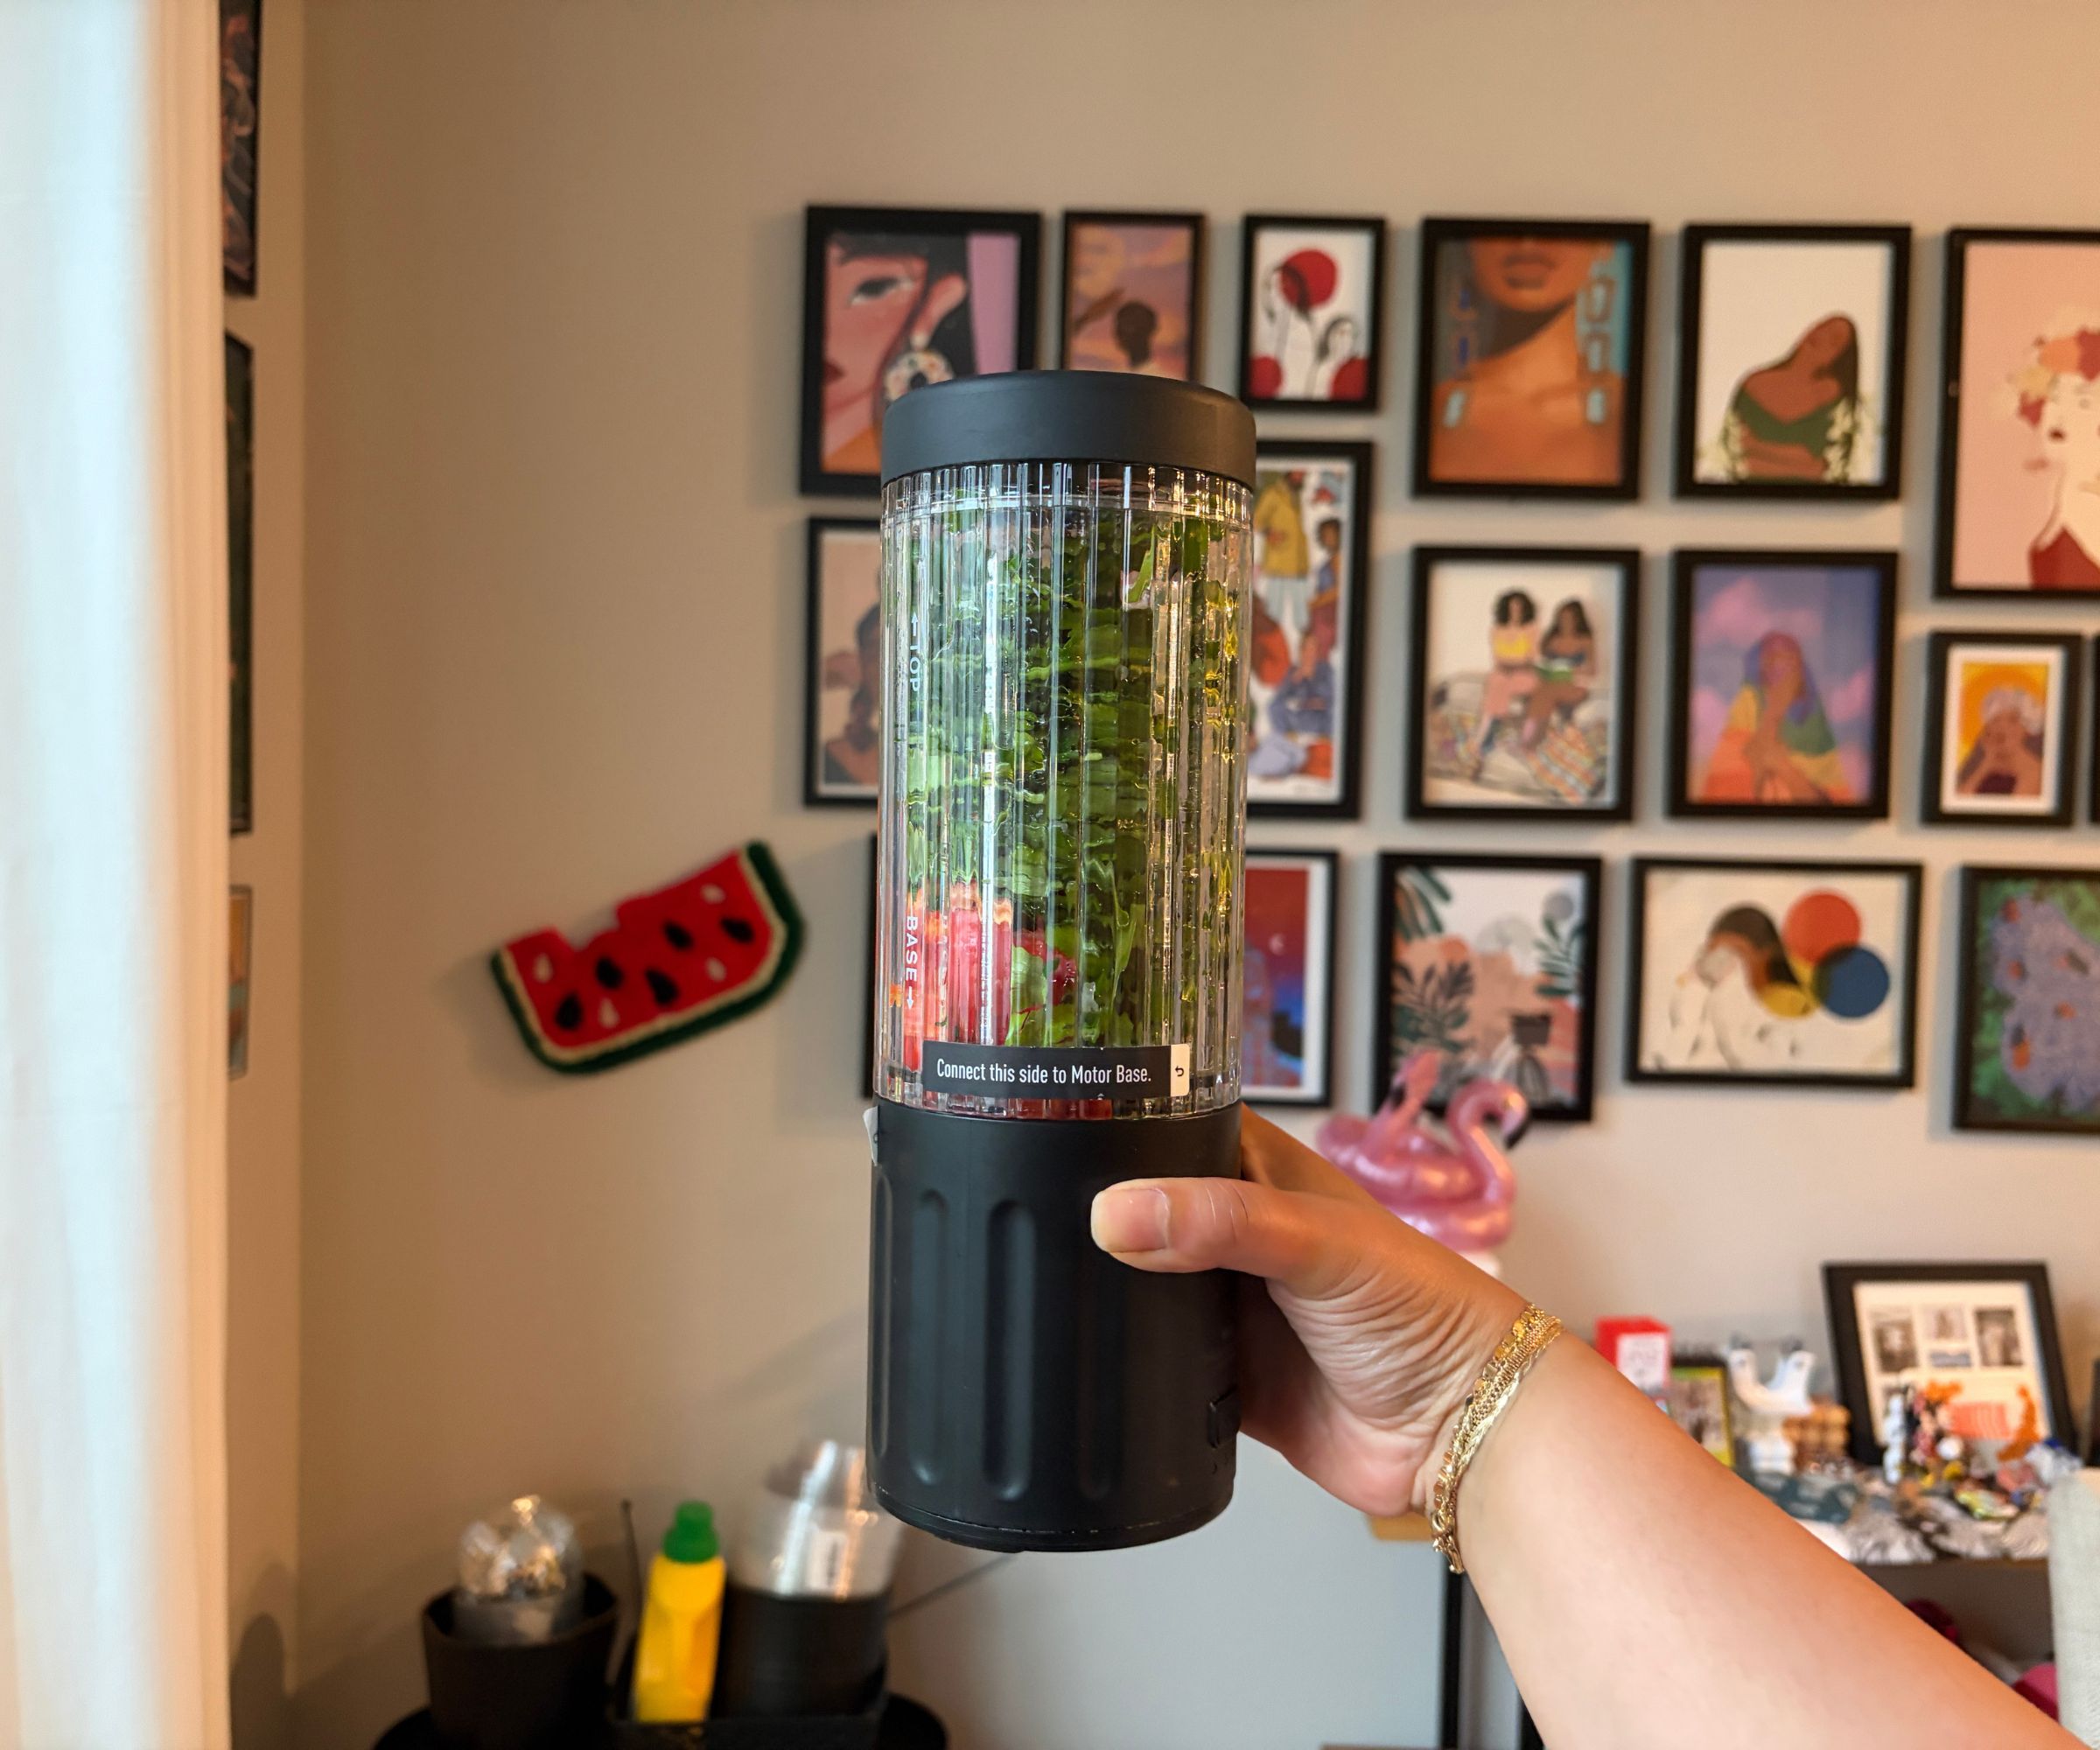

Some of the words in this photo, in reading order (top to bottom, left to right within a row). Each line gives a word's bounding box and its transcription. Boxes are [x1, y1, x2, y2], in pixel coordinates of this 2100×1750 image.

[906, 915, 919, 982] BASE
[936, 1058, 986, 1082] Connect
[989, 1062, 1016, 1083] this
[1018, 1064, 1048, 1084] side
[1052, 1066, 1067, 1084] to
[1071, 1065, 1112, 1084] Motor
[1116, 1064, 1152, 1083] Base.
